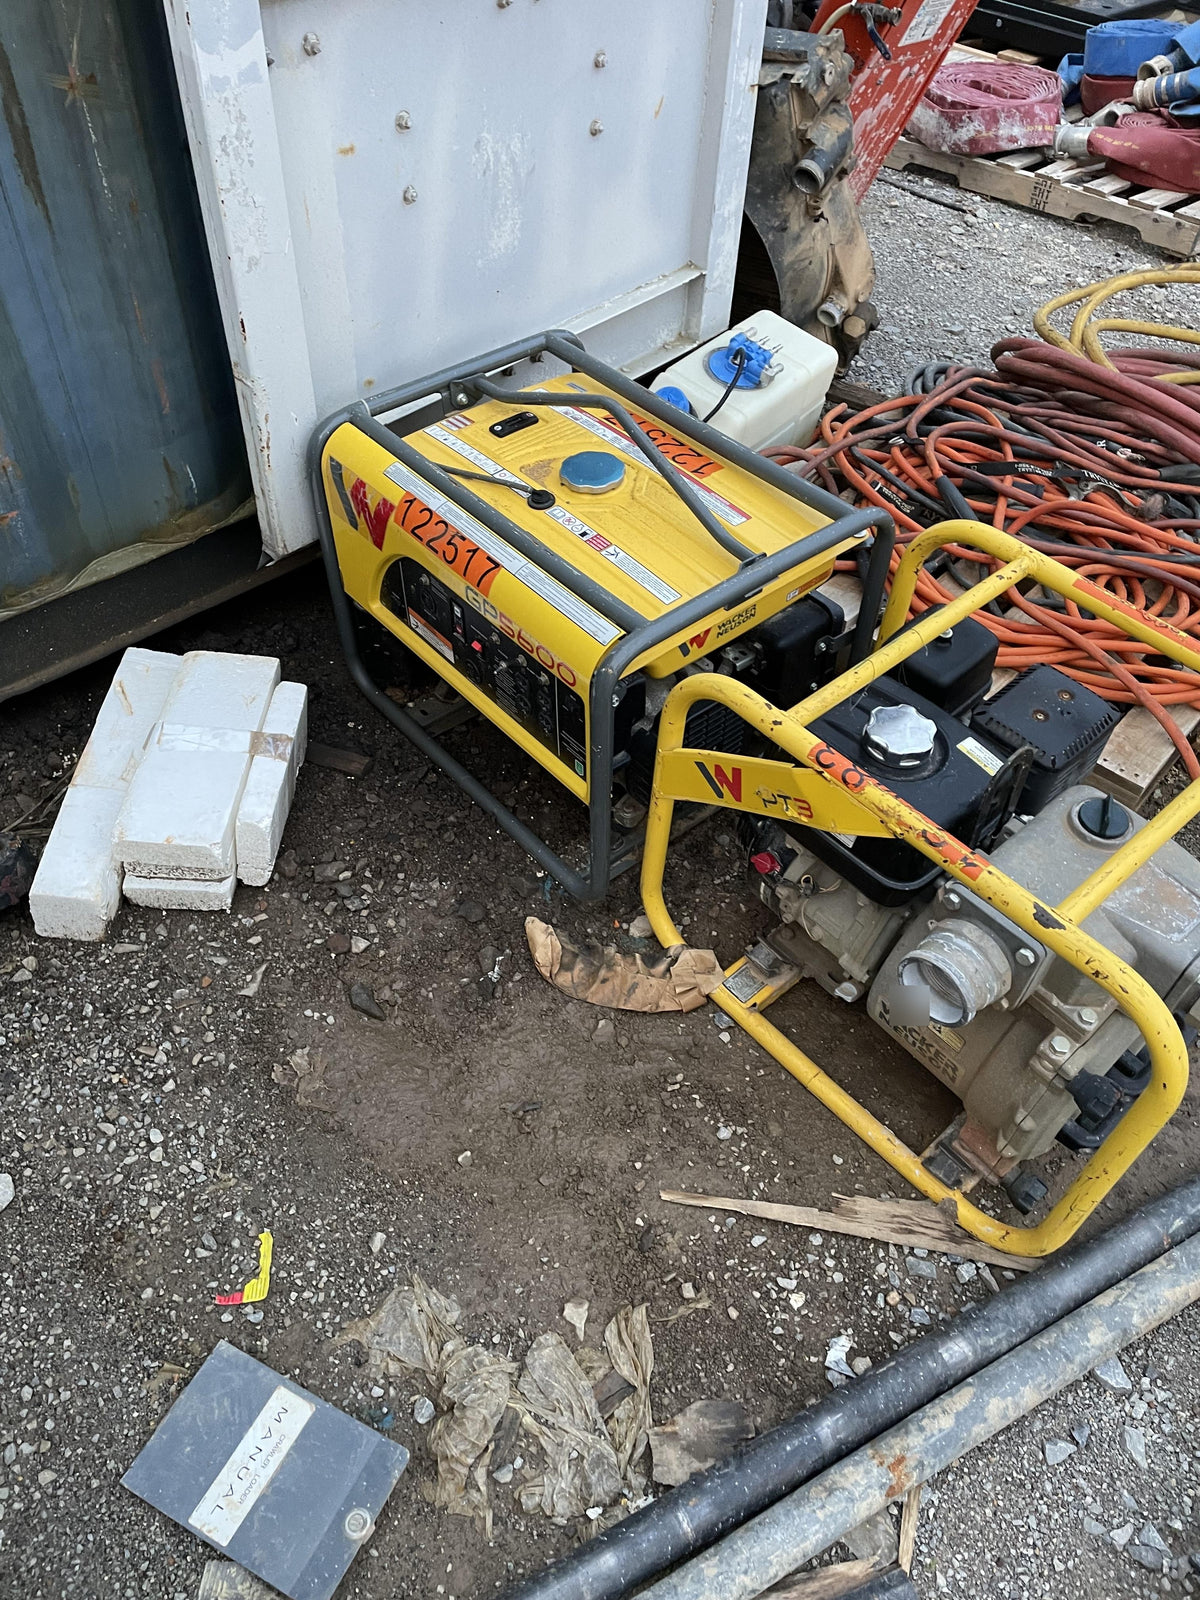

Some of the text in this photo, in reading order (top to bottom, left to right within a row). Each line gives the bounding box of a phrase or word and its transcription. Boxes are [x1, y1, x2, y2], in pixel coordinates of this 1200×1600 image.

[400, 497, 501, 588] 122517
[464, 585, 577, 687] GP5600
[716, 611, 757, 639] NEUSON
[717, 603, 757, 631] WACKER
[210, 1406, 289, 1516] MANUAL
[238, 1433, 287, 1506] CRAWLER LOADER
